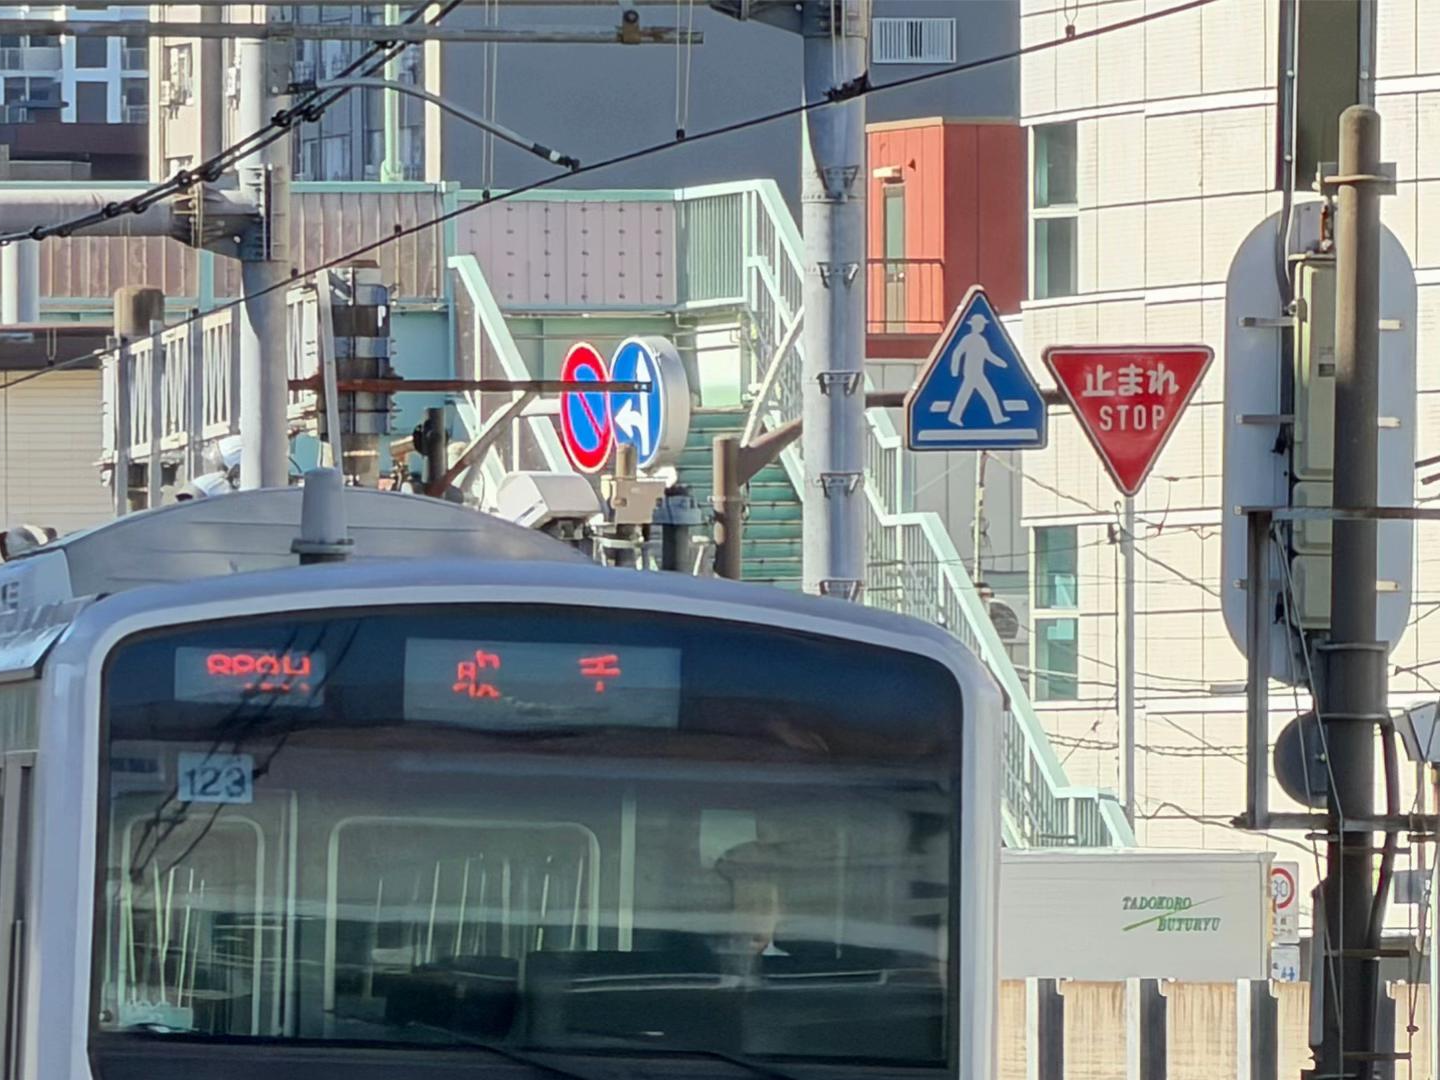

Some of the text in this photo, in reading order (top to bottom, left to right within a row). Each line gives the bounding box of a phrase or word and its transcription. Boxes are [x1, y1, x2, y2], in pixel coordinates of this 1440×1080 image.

[1081, 363, 1180, 398] 止まれ
[1098, 405, 1166, 431] STOP
[184, 767, 246, 798] 123
[1121, 895, 1193, 911] TADOKORO
[1156, 917, 1222, 932] BUTURYU
